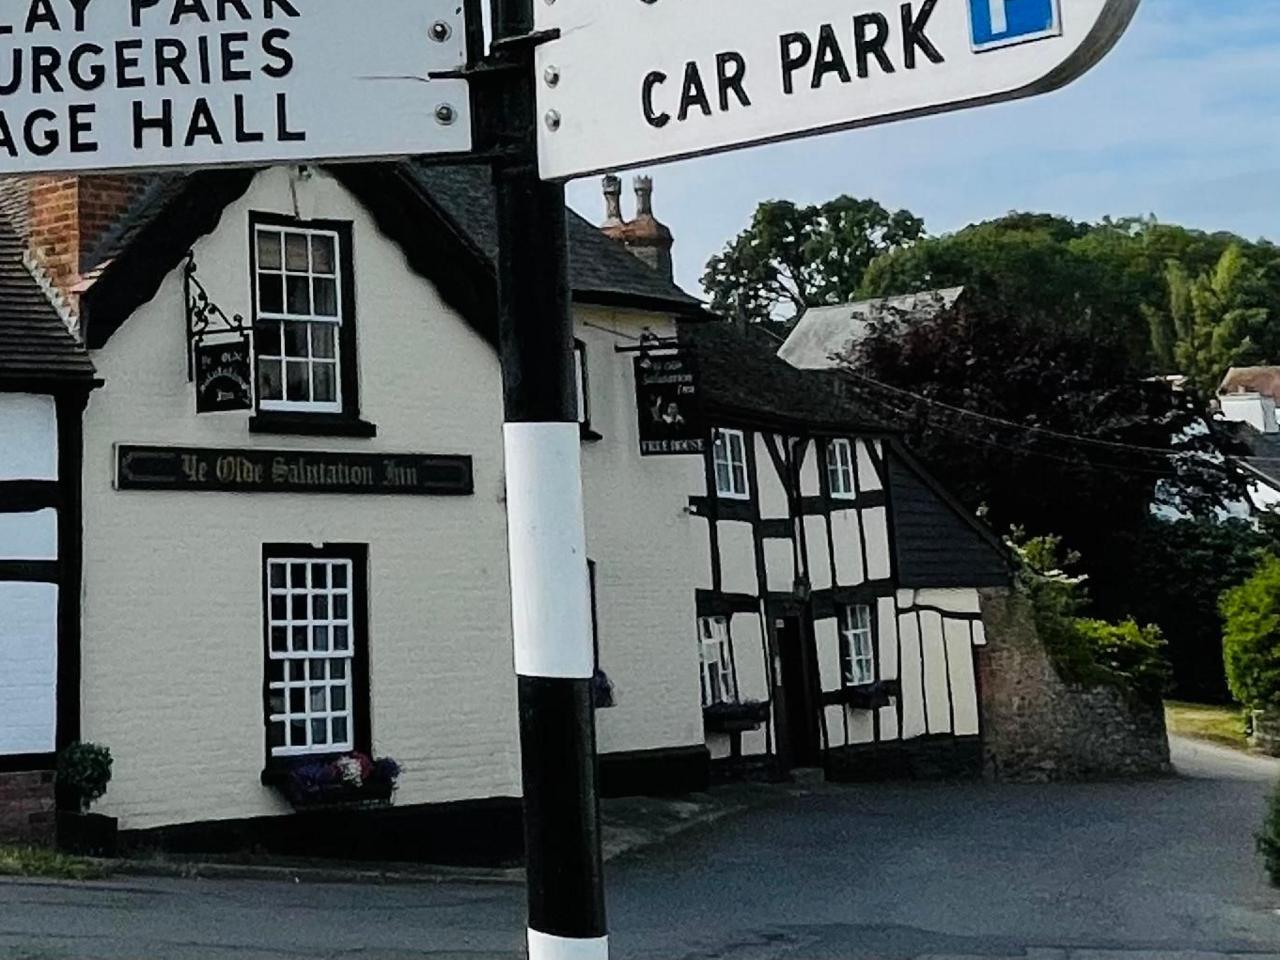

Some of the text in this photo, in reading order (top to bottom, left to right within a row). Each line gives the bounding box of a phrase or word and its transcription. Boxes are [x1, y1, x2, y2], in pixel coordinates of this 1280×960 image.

[641, 51, 752, 128] CAR
[132, 92, 306, 150] HALL
[180, 453, 419, 487] Ye Olde Salutation Inn
